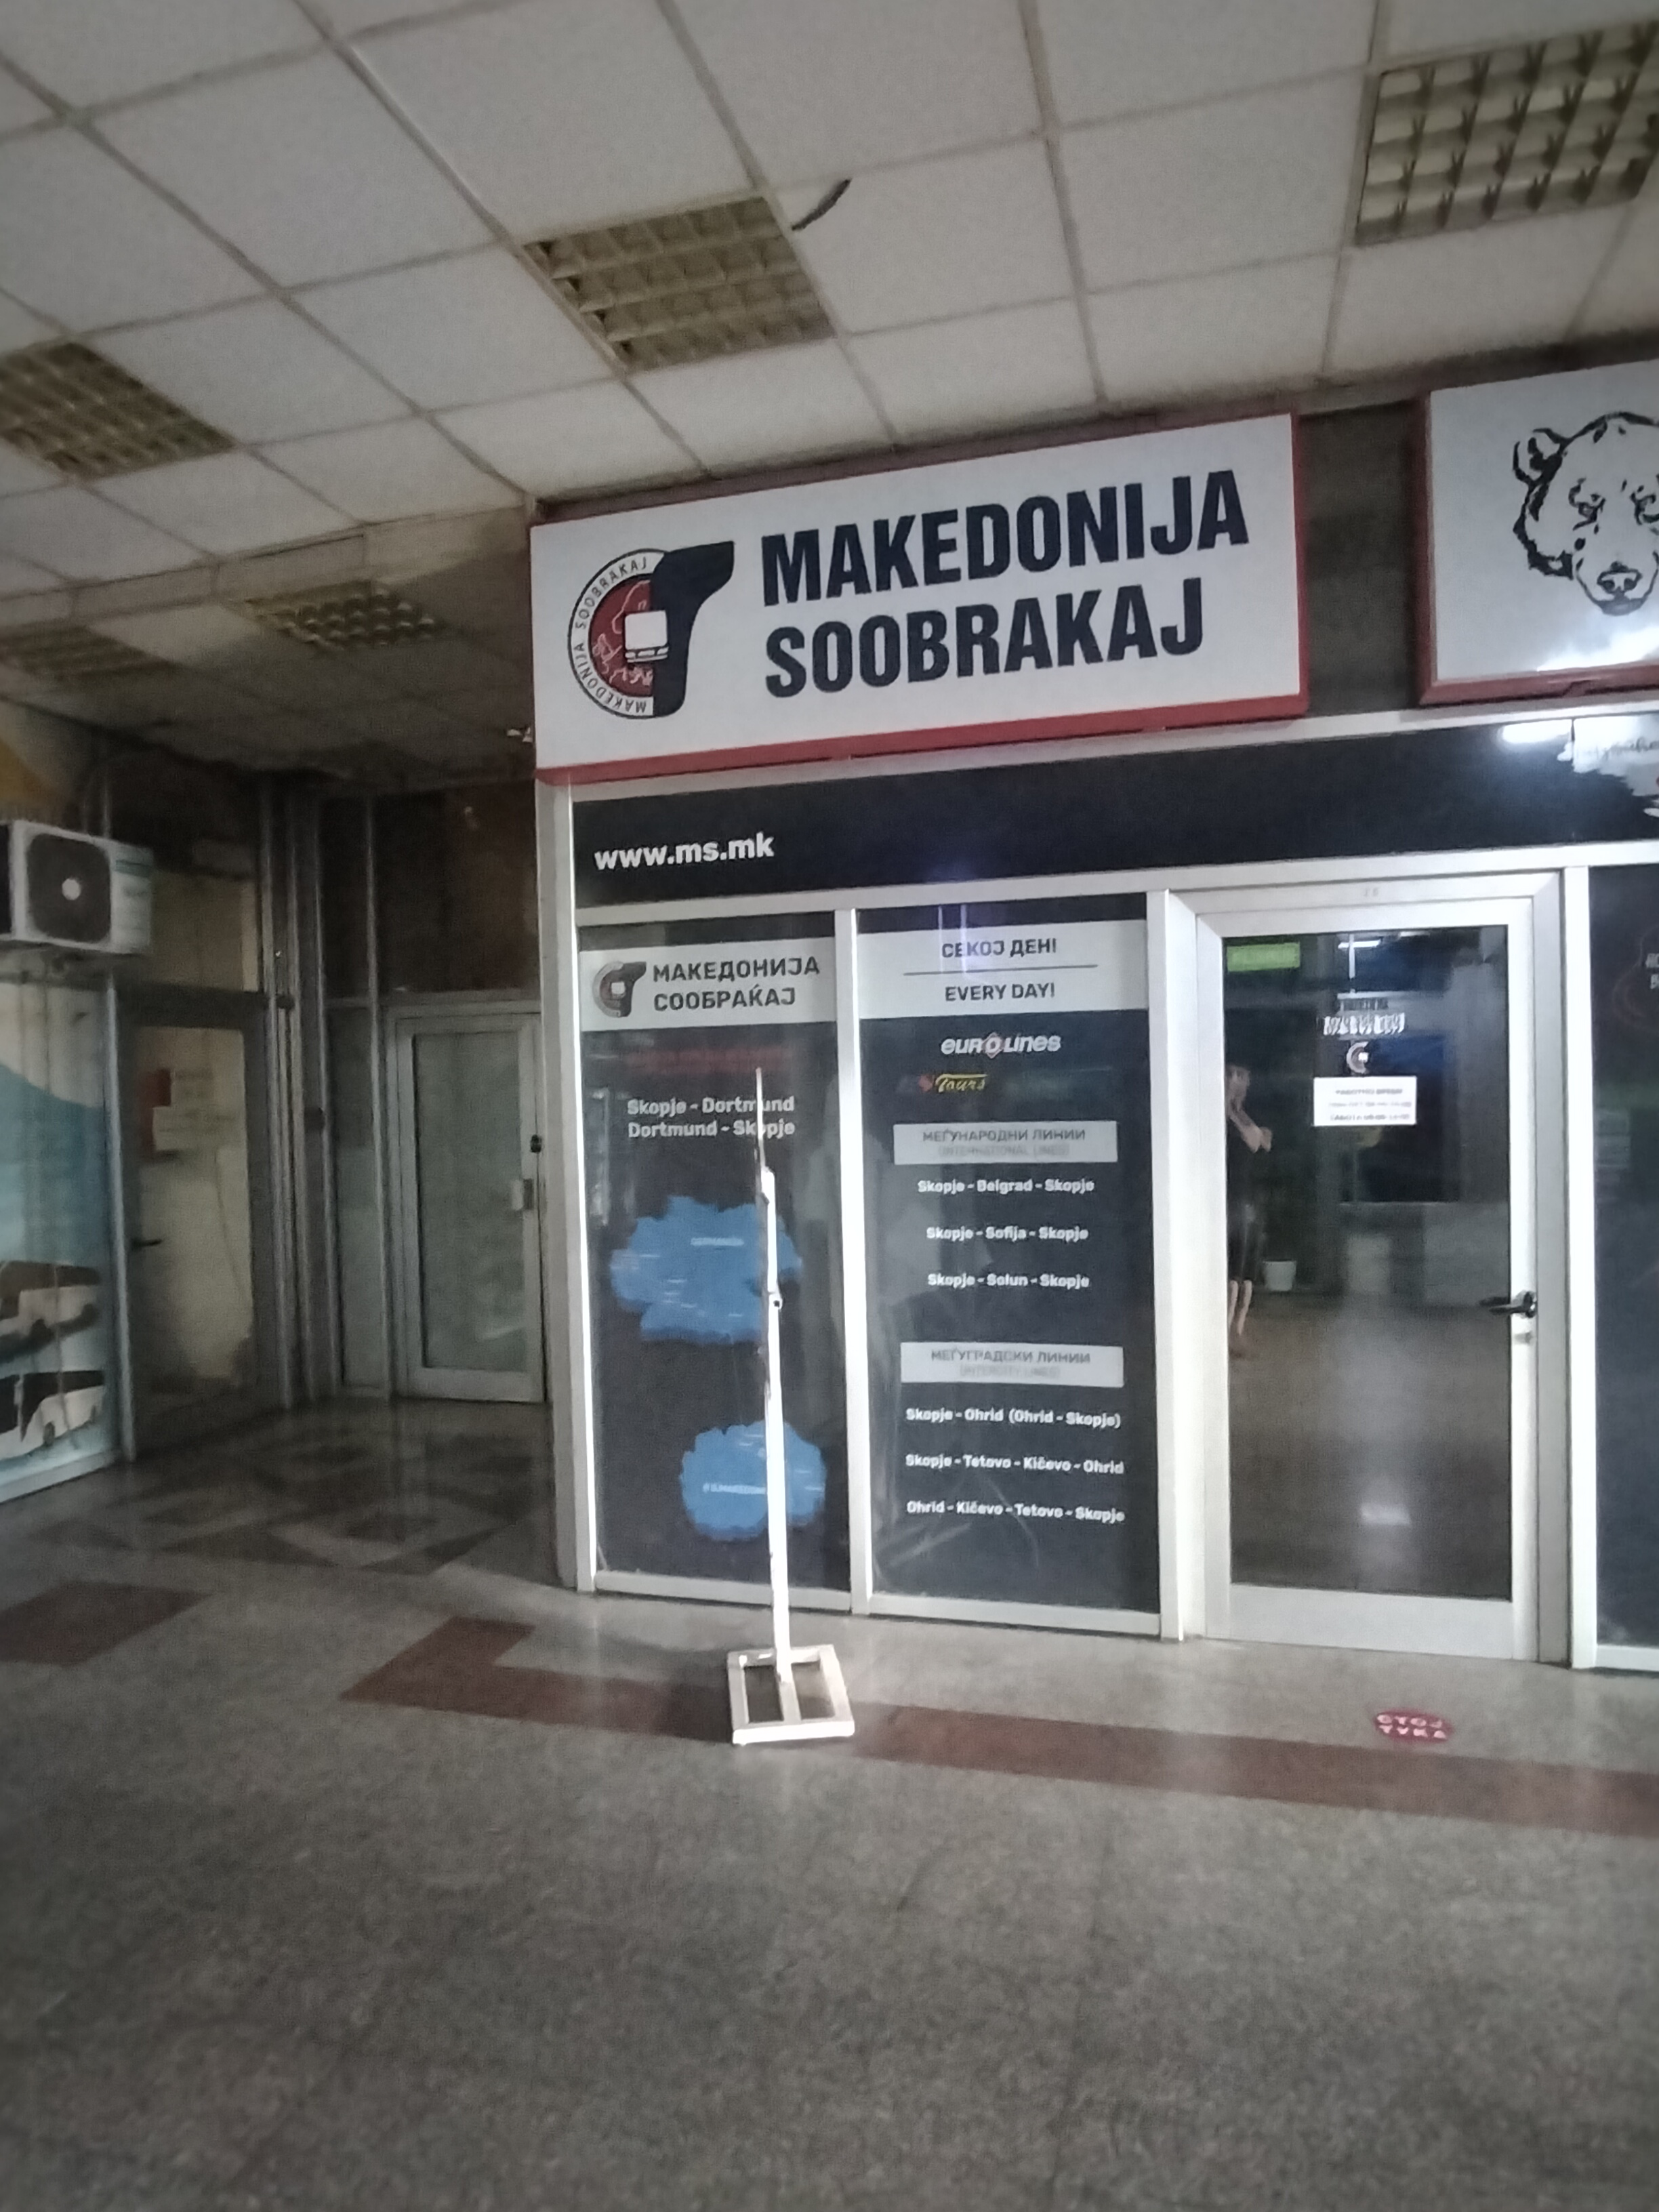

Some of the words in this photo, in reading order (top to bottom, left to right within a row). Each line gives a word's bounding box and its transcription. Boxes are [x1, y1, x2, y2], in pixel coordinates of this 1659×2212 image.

[762, 469, 1249, 607] MAKEDONIJA
[575, 556, 647, 630] SOOBRAKAJ
[765, 577, 1203, 699] SOOBRAKAJ
[574, 642, 647, 714] MAKEDONIJA
[594, 832, 775, 870] www.ms.mk
[942, 940, 1004, 958] СЕКОЈ
[1010, 938, 1057, 957] ДЕН!
[653, 956, 820, 983] МАКЕДОНИЈА
[654, 984, 796, 1011] СООБРАЌАЈ
[945, 985, 1006, 1001] EVERY
[1012, 983, 1055, 999] DAY!
[627, 1098, 687, 1118] Skopje
[628, 1120, 717, 1138] Dortmund
[733, 1118, 795, 1139] Skpje
[1033, 1128, 1085, 1141] ЛИНИИ
[918, 1179, 964, 1195] Skopje
[977, 1179, 1032, 1195] Belgrad
[1044, 1179, 1094, 1194] Skopje
[926, 1226, 973, 1242] Skopje
[985, 1226, 1026, 1242] Sofija
[1039, 1226, 1088, 1242] Skopje
[928, 1273, 975, 1288] Skopje
[987, 1273, 1028, 1287] Solun
[1040, 1273, 1090, 1290] Skopje
[906, 1407, 953, 1422] Skopje
[964, 1408, 1004, 1422] Ohrid
[1008, 1408, 1053, 1423] (Ohrid
[1066, 1412, 1121, 1429] Skopje)
[905, 1454, 951, 1471] Skopje
[963, 1454, 1011, 1468] Tetovo
[1084, 1460, 1124, 1474] Ohrid
[907, 1501, 945, 1513] Ohrid
[1015, 1503, 1063, 1518] Tetovo
[1075, 1507, 1125, 1523] Skopje
